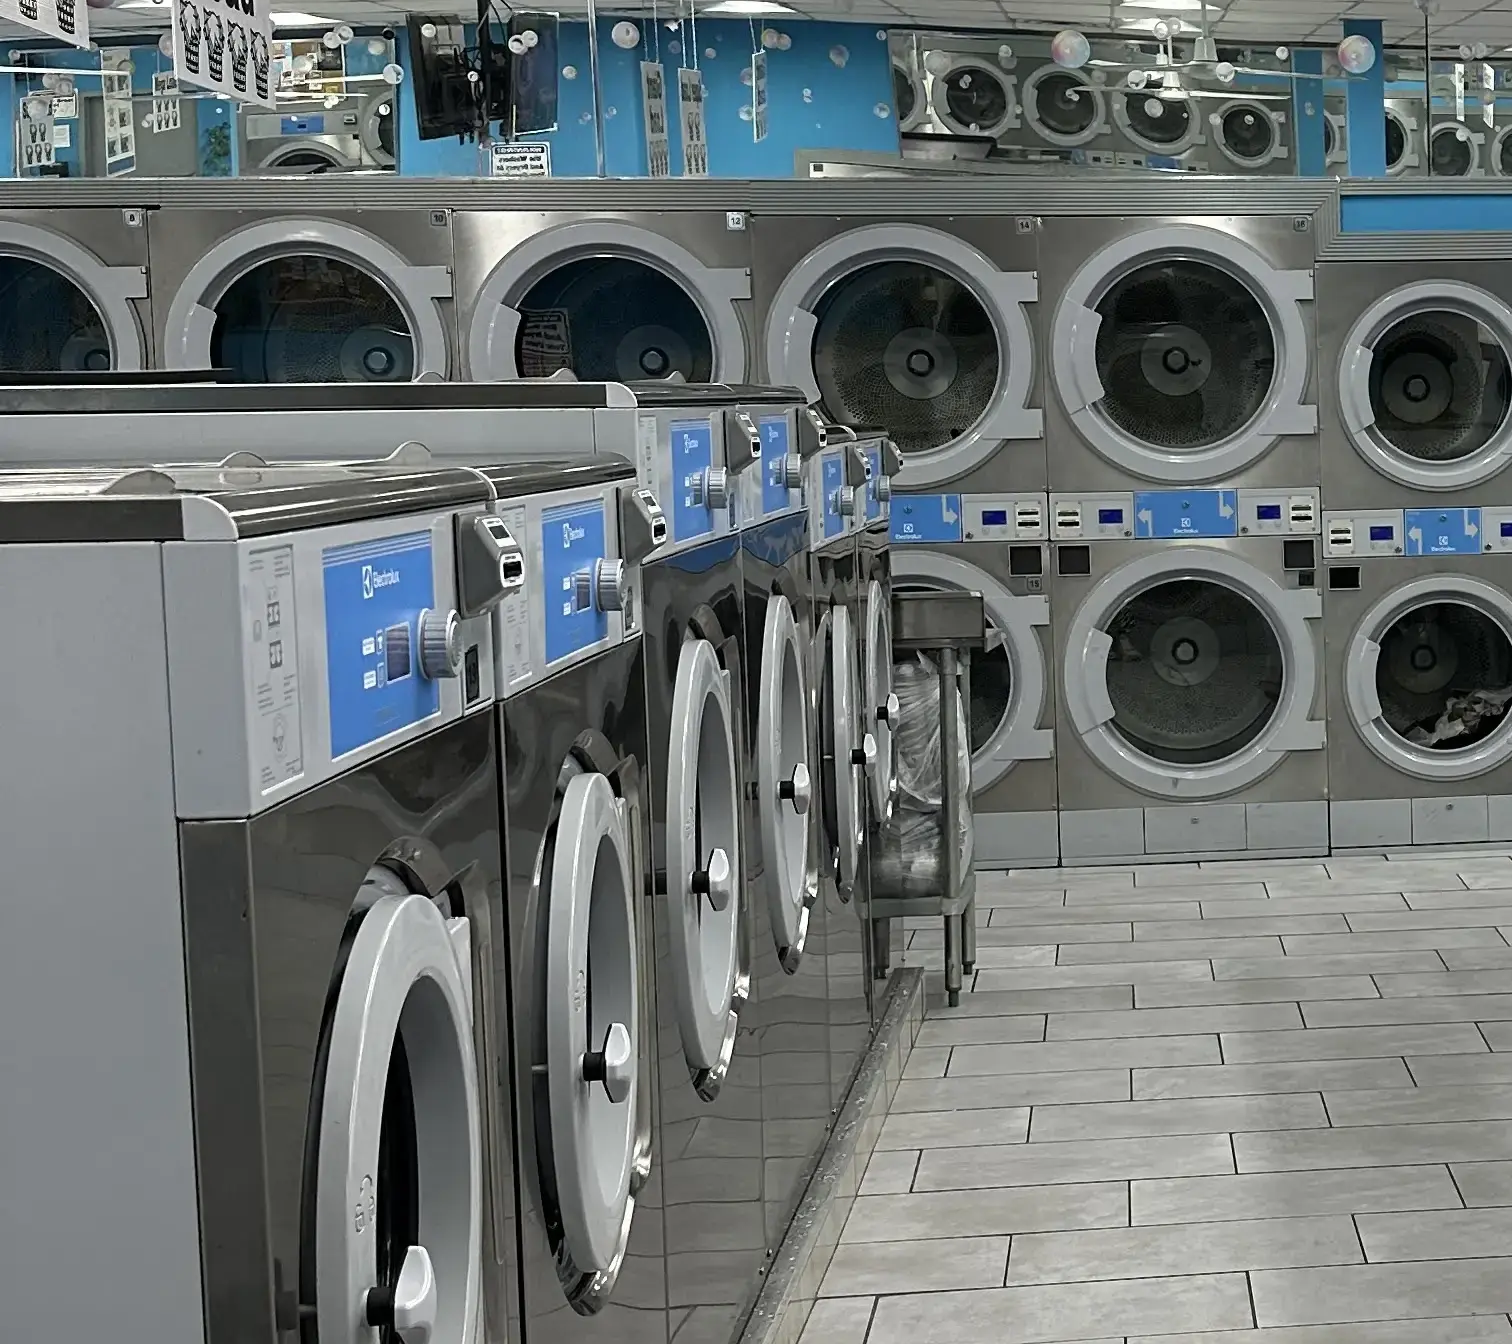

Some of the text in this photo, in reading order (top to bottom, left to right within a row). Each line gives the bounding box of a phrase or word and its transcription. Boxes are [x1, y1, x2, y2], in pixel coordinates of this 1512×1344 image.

[433, 214, 443, 222] 10
[731, 217, 741, 226] 12
[1020, 221, 1029, 229] 14
[373, 568, 400, 589] Electrolux
